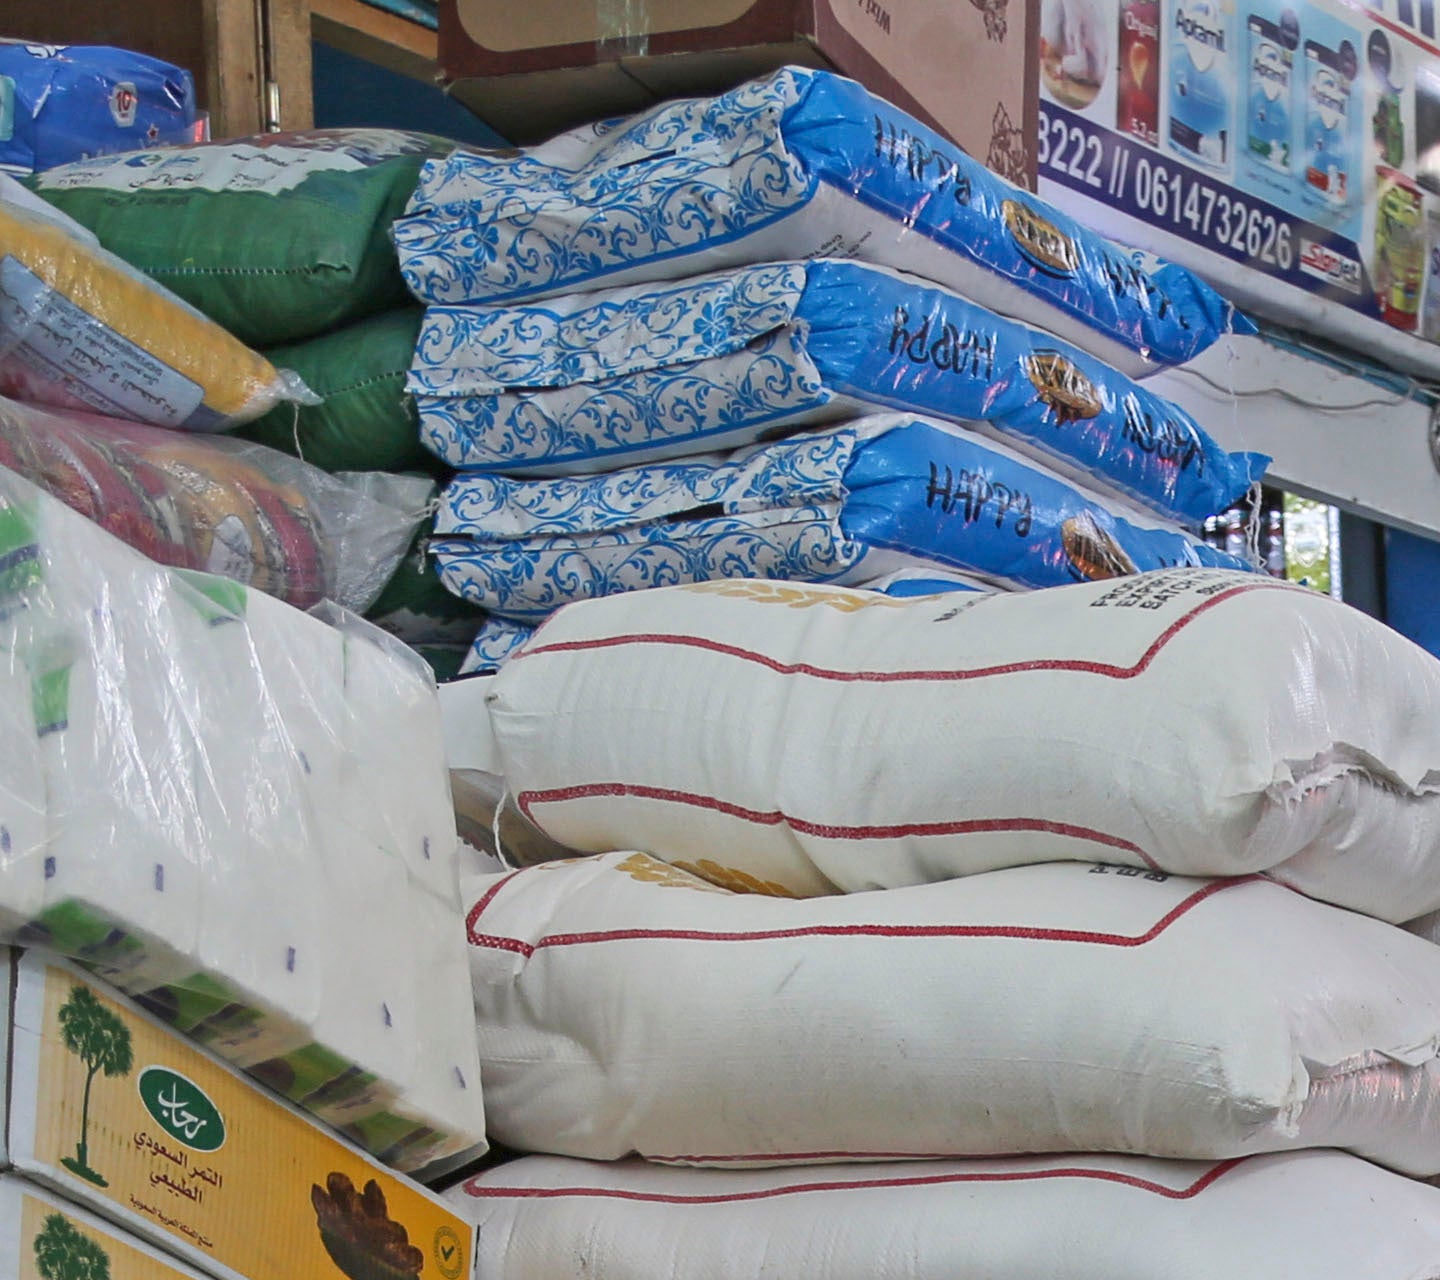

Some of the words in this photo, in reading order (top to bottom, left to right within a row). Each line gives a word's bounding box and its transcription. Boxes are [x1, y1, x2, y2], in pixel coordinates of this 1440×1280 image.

[1175, 8, 1225, 43] Aptamil
[115, 88, 135, 112] 10
[1135, 159, 1292, 270] 0614732626
[132, 1131, 188, 1168] السعودي
[149, 1169, 203, 1204] الطبيعي
[189, 1161, 224, 1188] التمر
